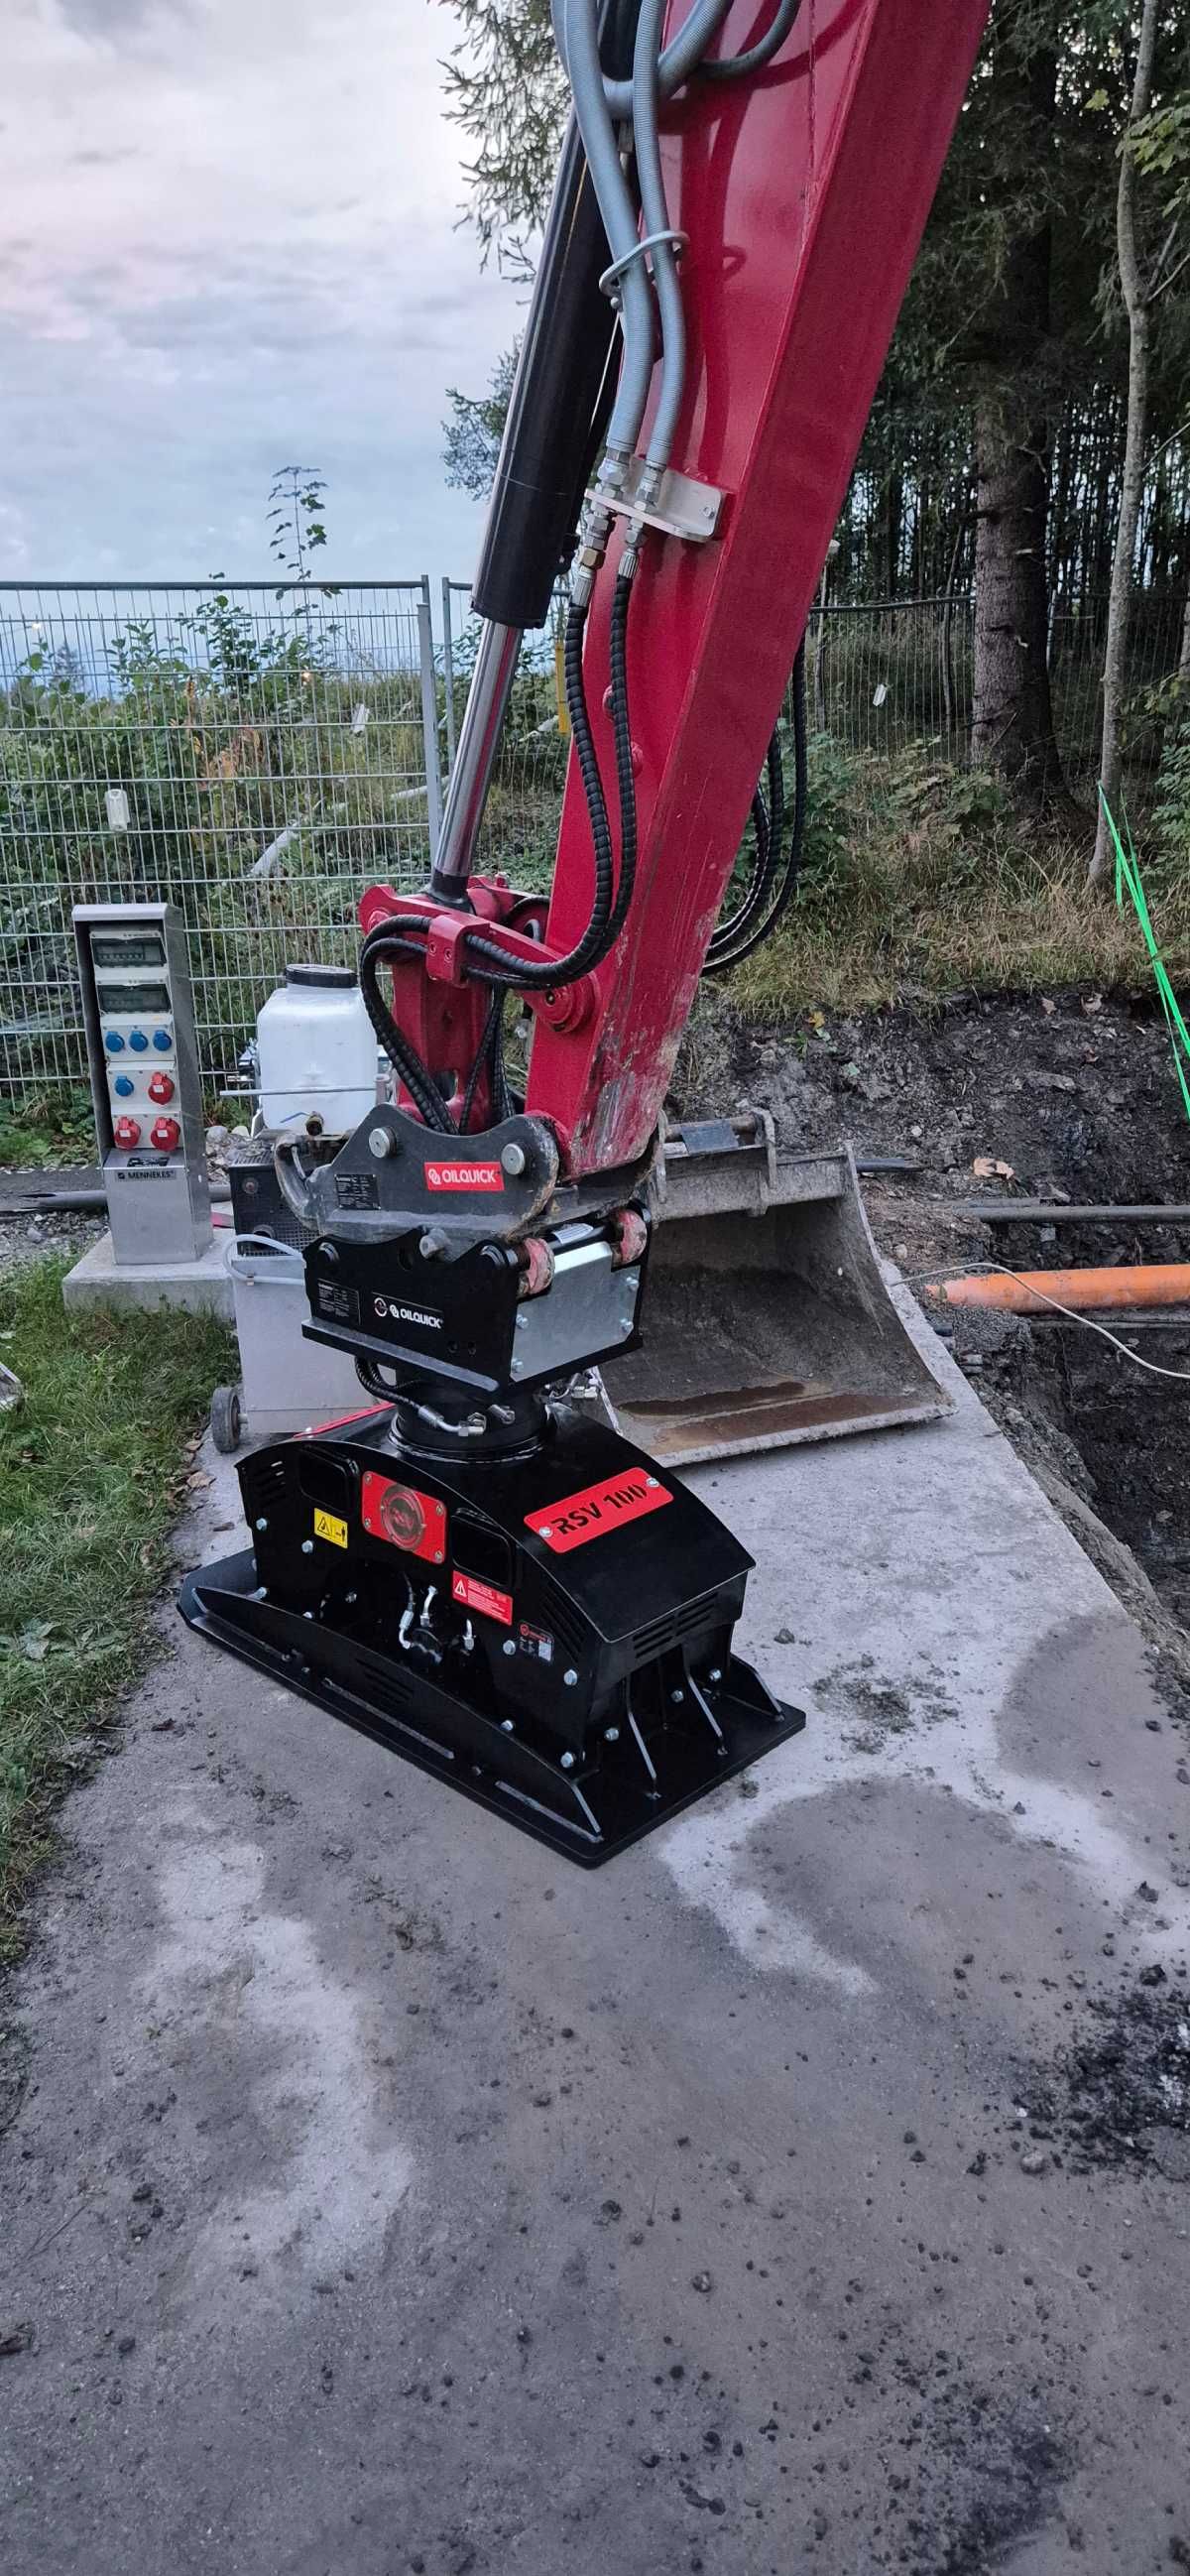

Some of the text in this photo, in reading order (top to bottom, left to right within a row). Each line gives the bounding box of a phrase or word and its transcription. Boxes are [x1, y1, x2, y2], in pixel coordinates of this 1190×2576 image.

[442, 1169, 496, 1182] OILQUICK
[400, 1308, 441, 1329] OILQUICK
[550, 1484, 648, 1534] RSV 100
